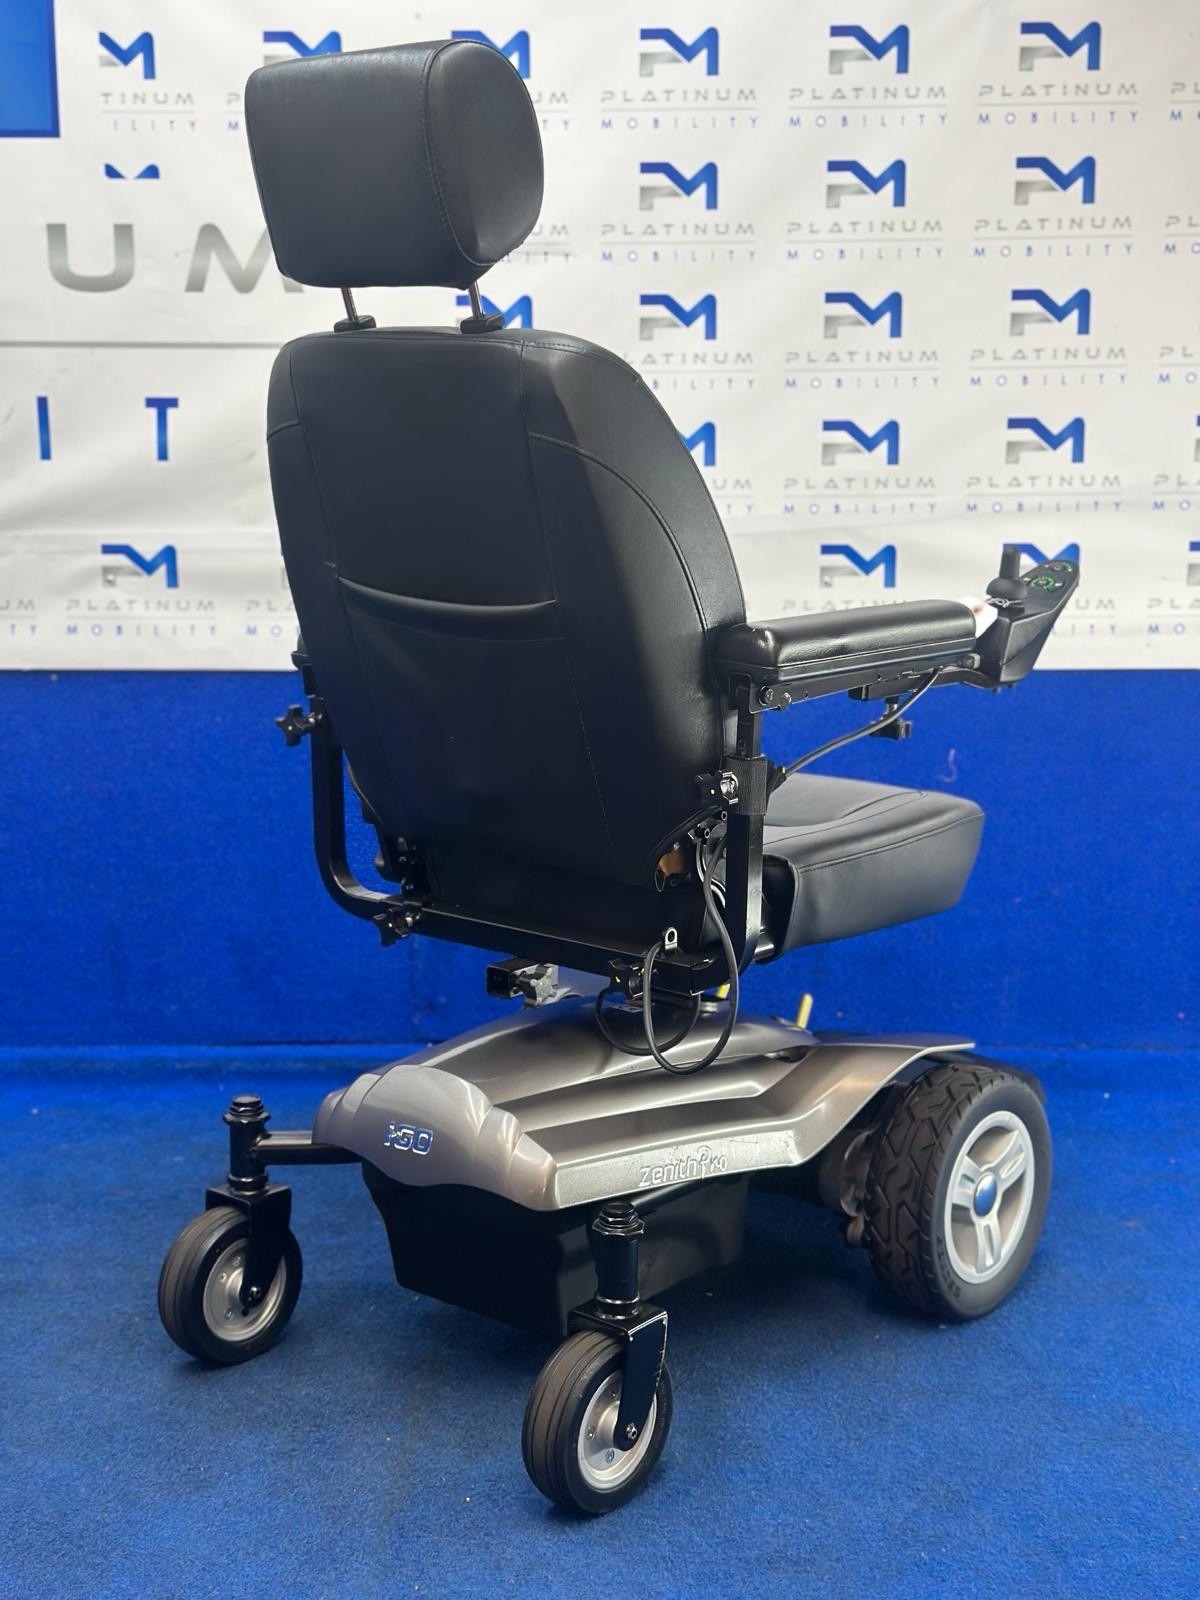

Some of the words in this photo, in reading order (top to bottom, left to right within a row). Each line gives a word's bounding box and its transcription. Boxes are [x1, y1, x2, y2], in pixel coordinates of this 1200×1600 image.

[601, 88, 757, 102] PLATINUM
[790, 86, 946, 100] PLATINUM
[979, 82, 1138, 97] PLATINUM
[100, 92, 194, 104] TINUM
[601, 116, 758, 129] MOBILITY
[789, 114, 947, 128] MOBILITY
[978, 111, 1139, 124] MOBILITY
[114, 120, 197, 131] ILITY
[602, 222, 755, 235] PLATINUM
[787, 221, 942, 234] PLATINUM
[974, 216, 1132, 231] PLATINUM
[602, 250, 756, 262] MOBILITY
[788, 247, 943, 260] MOBILITY
[974, 244, 1133, 258] MOBILITY
[624, 353, 754, 365] LATINUM
[785, 350, 938, 363] PLATINUM
[971, 347, 1126, 361] PLATINUM
[653, 379, 755, 390] BILITY
[785, 376, 938, 388] MOBILITY
[970, 374, 1128, 386] MOBILITY
[784, 477, 935, 489] PLATINUM
[966, 475, 1121, 488] PLATINUM
[784, 503, 935, 514] MOBILITY
[966, 501, 1122, 513] MOBILITY
[66, 597, 215, 611] PLATINUM
[66, 624, 217, 636] MOBILITY
